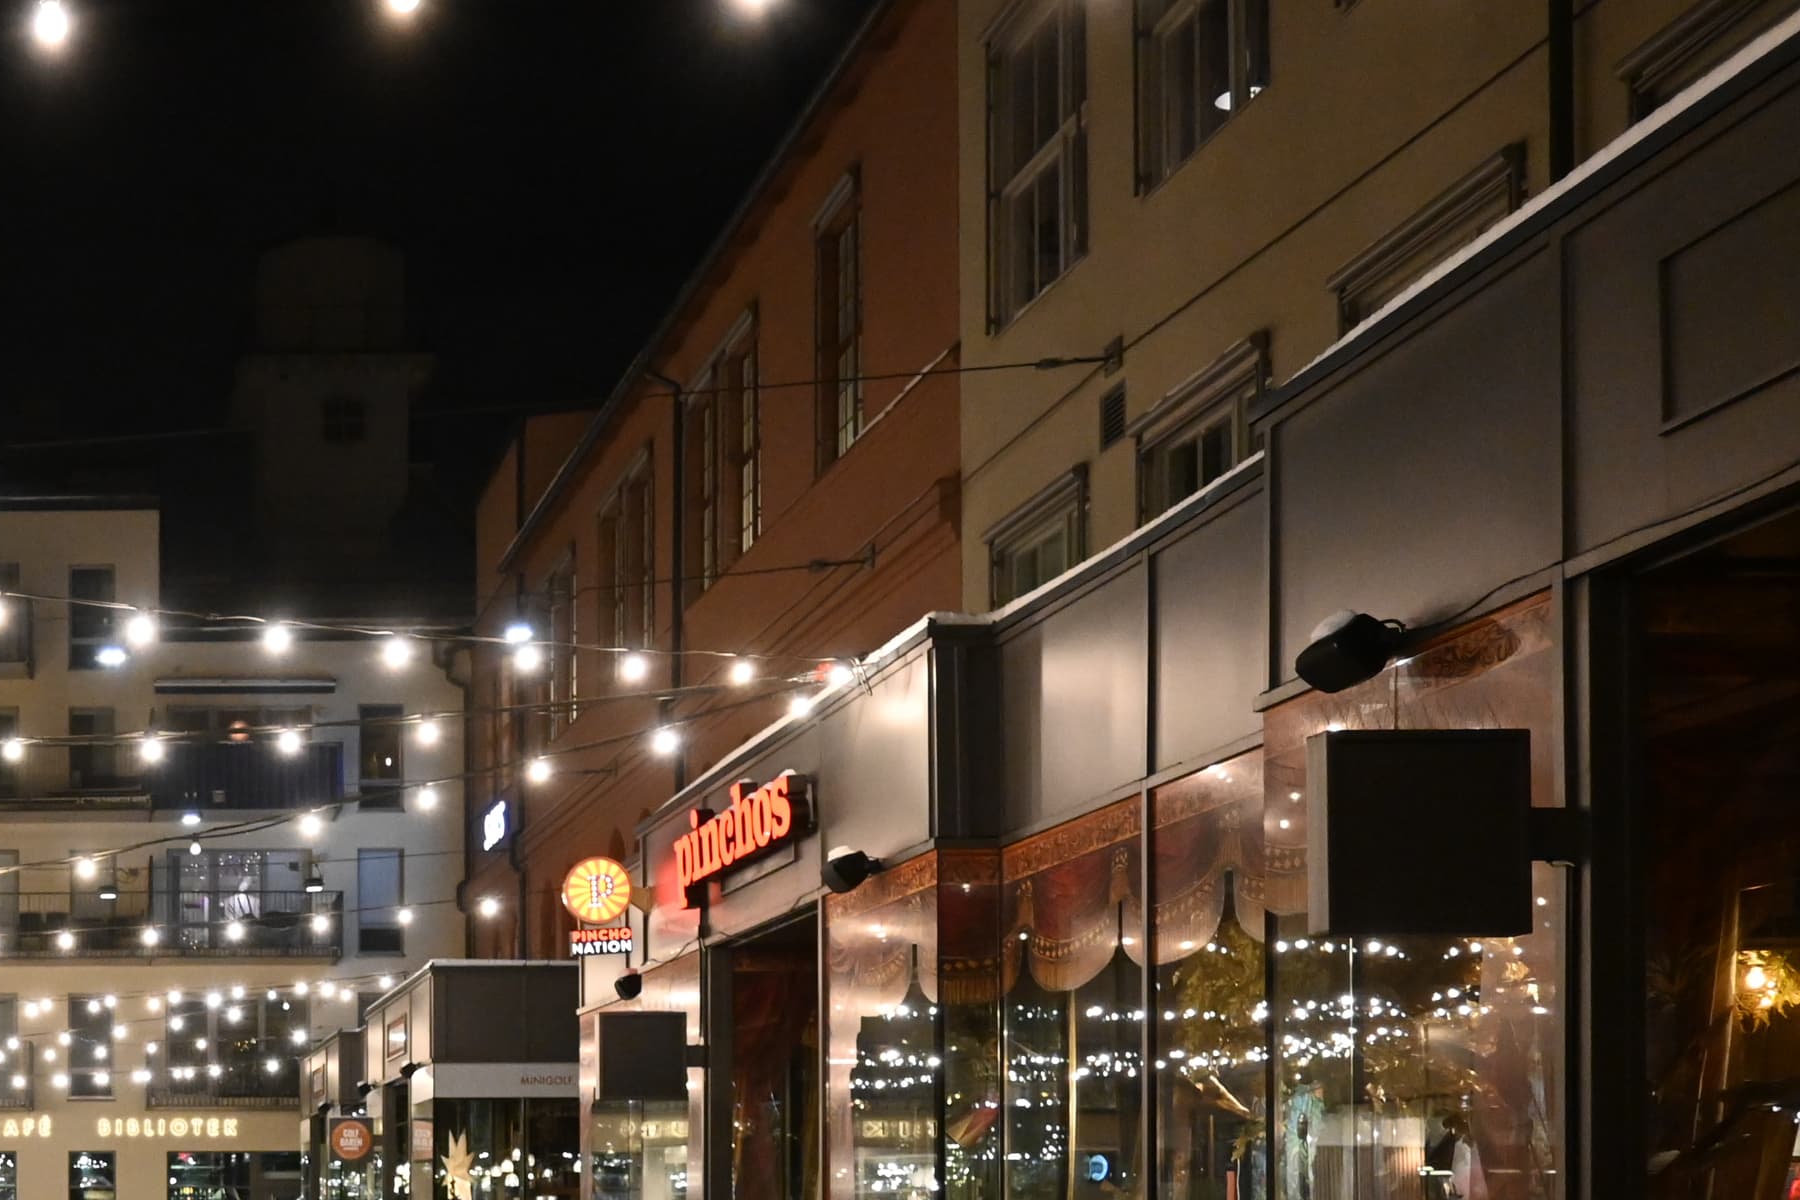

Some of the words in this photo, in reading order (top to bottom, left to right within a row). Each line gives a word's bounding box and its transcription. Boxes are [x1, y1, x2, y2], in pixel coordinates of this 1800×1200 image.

[674, 775, 791, 909] pinchos
[588, 875, 614, 908] P
[572, 928, 632, 942] PINCHO
[571, 939, 632, 955] NATION
[97, 1118, 238, 1137] BIBLIOTEK
